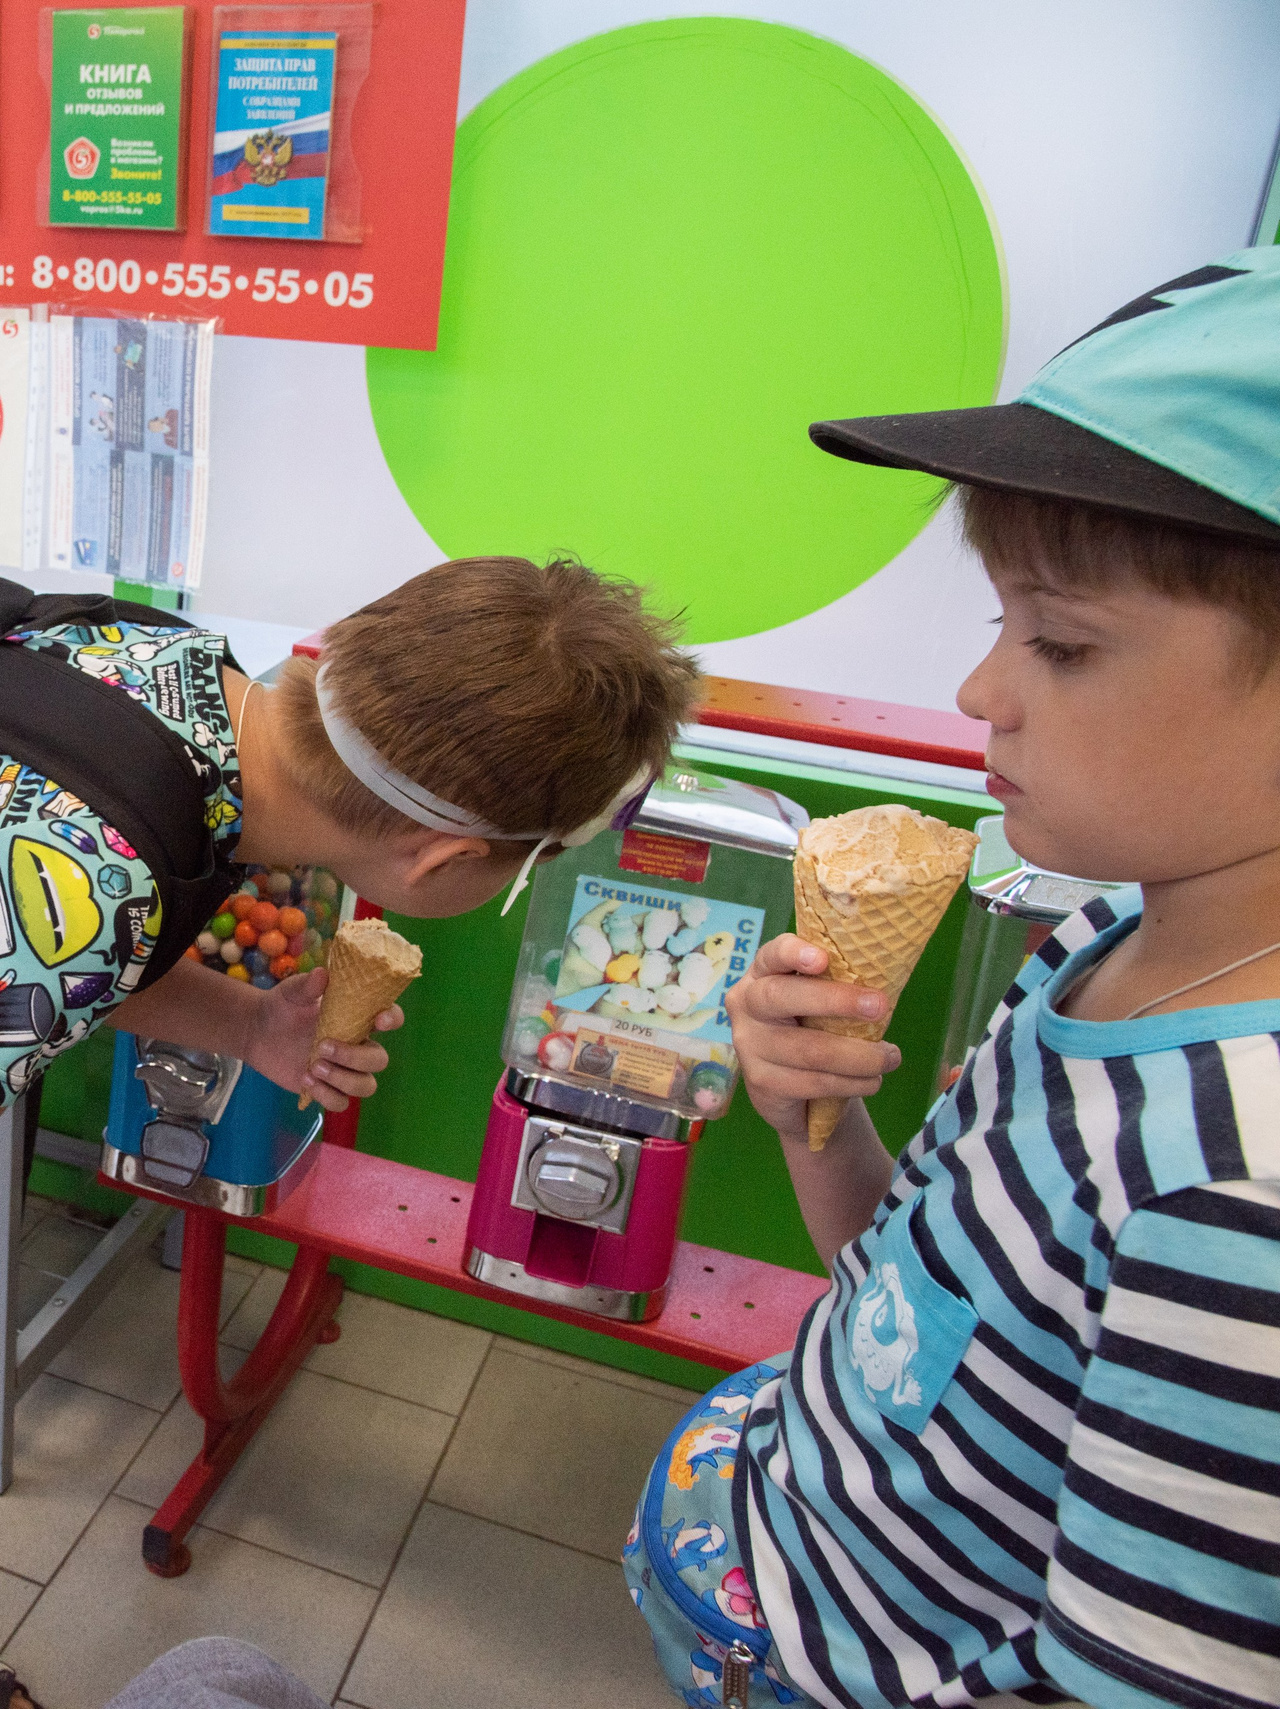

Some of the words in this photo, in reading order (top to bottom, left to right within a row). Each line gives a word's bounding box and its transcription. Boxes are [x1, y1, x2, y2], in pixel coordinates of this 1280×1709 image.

[234, 57, 283, 72] ЗАЩИТА
[284, 58, 317, 72] ПРАВ
[80, 64, 152, 84] КНИГА
[228, 75, 318, 91] ПОТРЕБИТЕЛЕЙ
[87, 88, 143, 99] ОТЗЫВОВ
[64, 104, 74, 114] И
[76, 102, 165, 116] ПРЕДЛОЖЕНИЙ
[62, 189, 162, 205] 8-800-555-55-05
[615, 1019, 629, 1032] 20
[631, 1023, 653, 1038] РУБ
